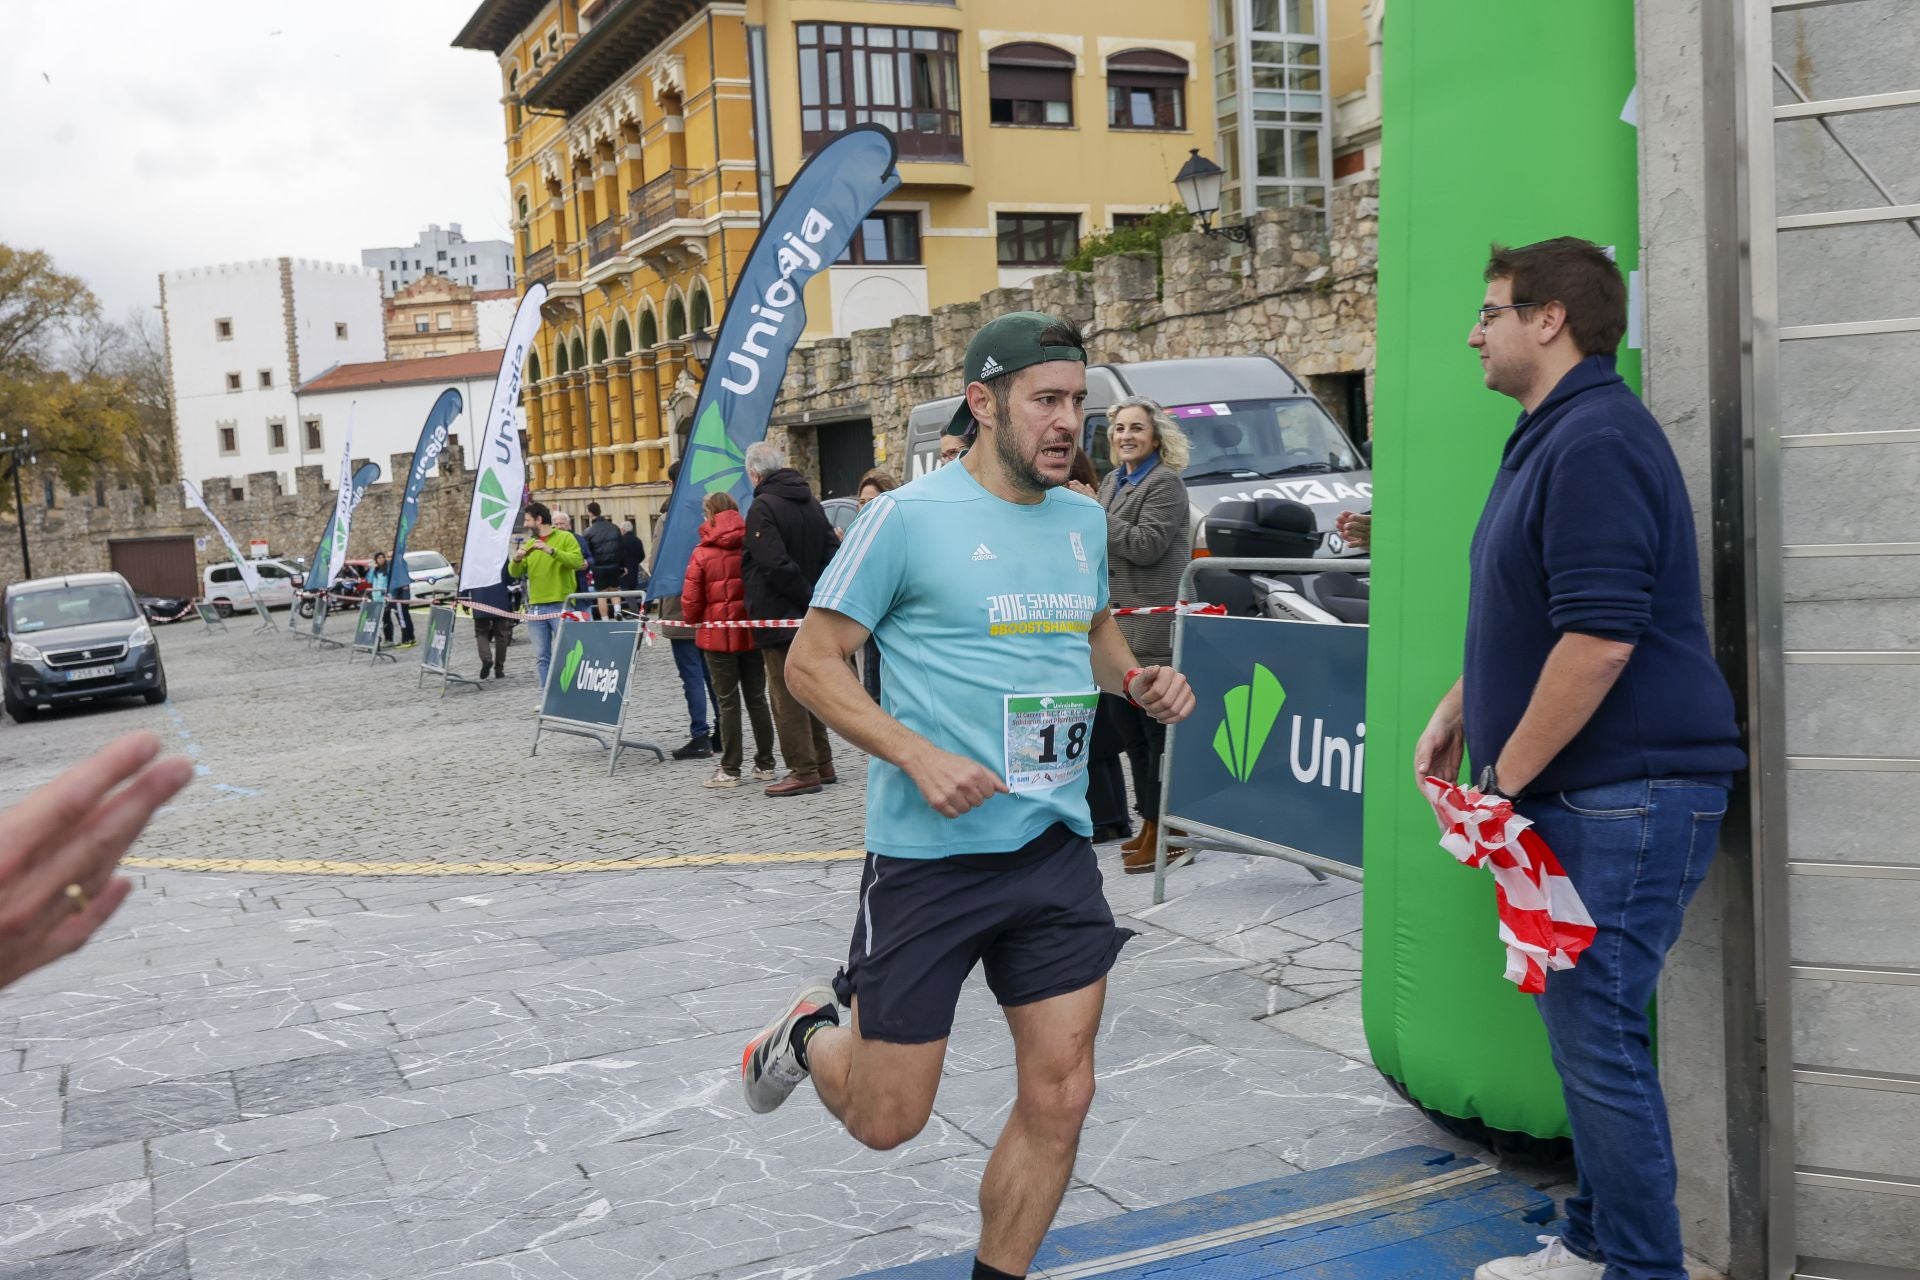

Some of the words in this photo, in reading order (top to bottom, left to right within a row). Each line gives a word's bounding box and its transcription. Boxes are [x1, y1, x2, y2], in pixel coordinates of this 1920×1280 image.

[720, 207, 834, 396] Unicaja
[980, 365, 1004, 379] adidas
[986, 593, 1028, 623] 2016
[1028, 609, 1054, 620] HALF
[576, 659, 620, 702] Unicaja
[1038, 722, 1088, 764] 18
[1289, 714, 1366, 794] Uni
